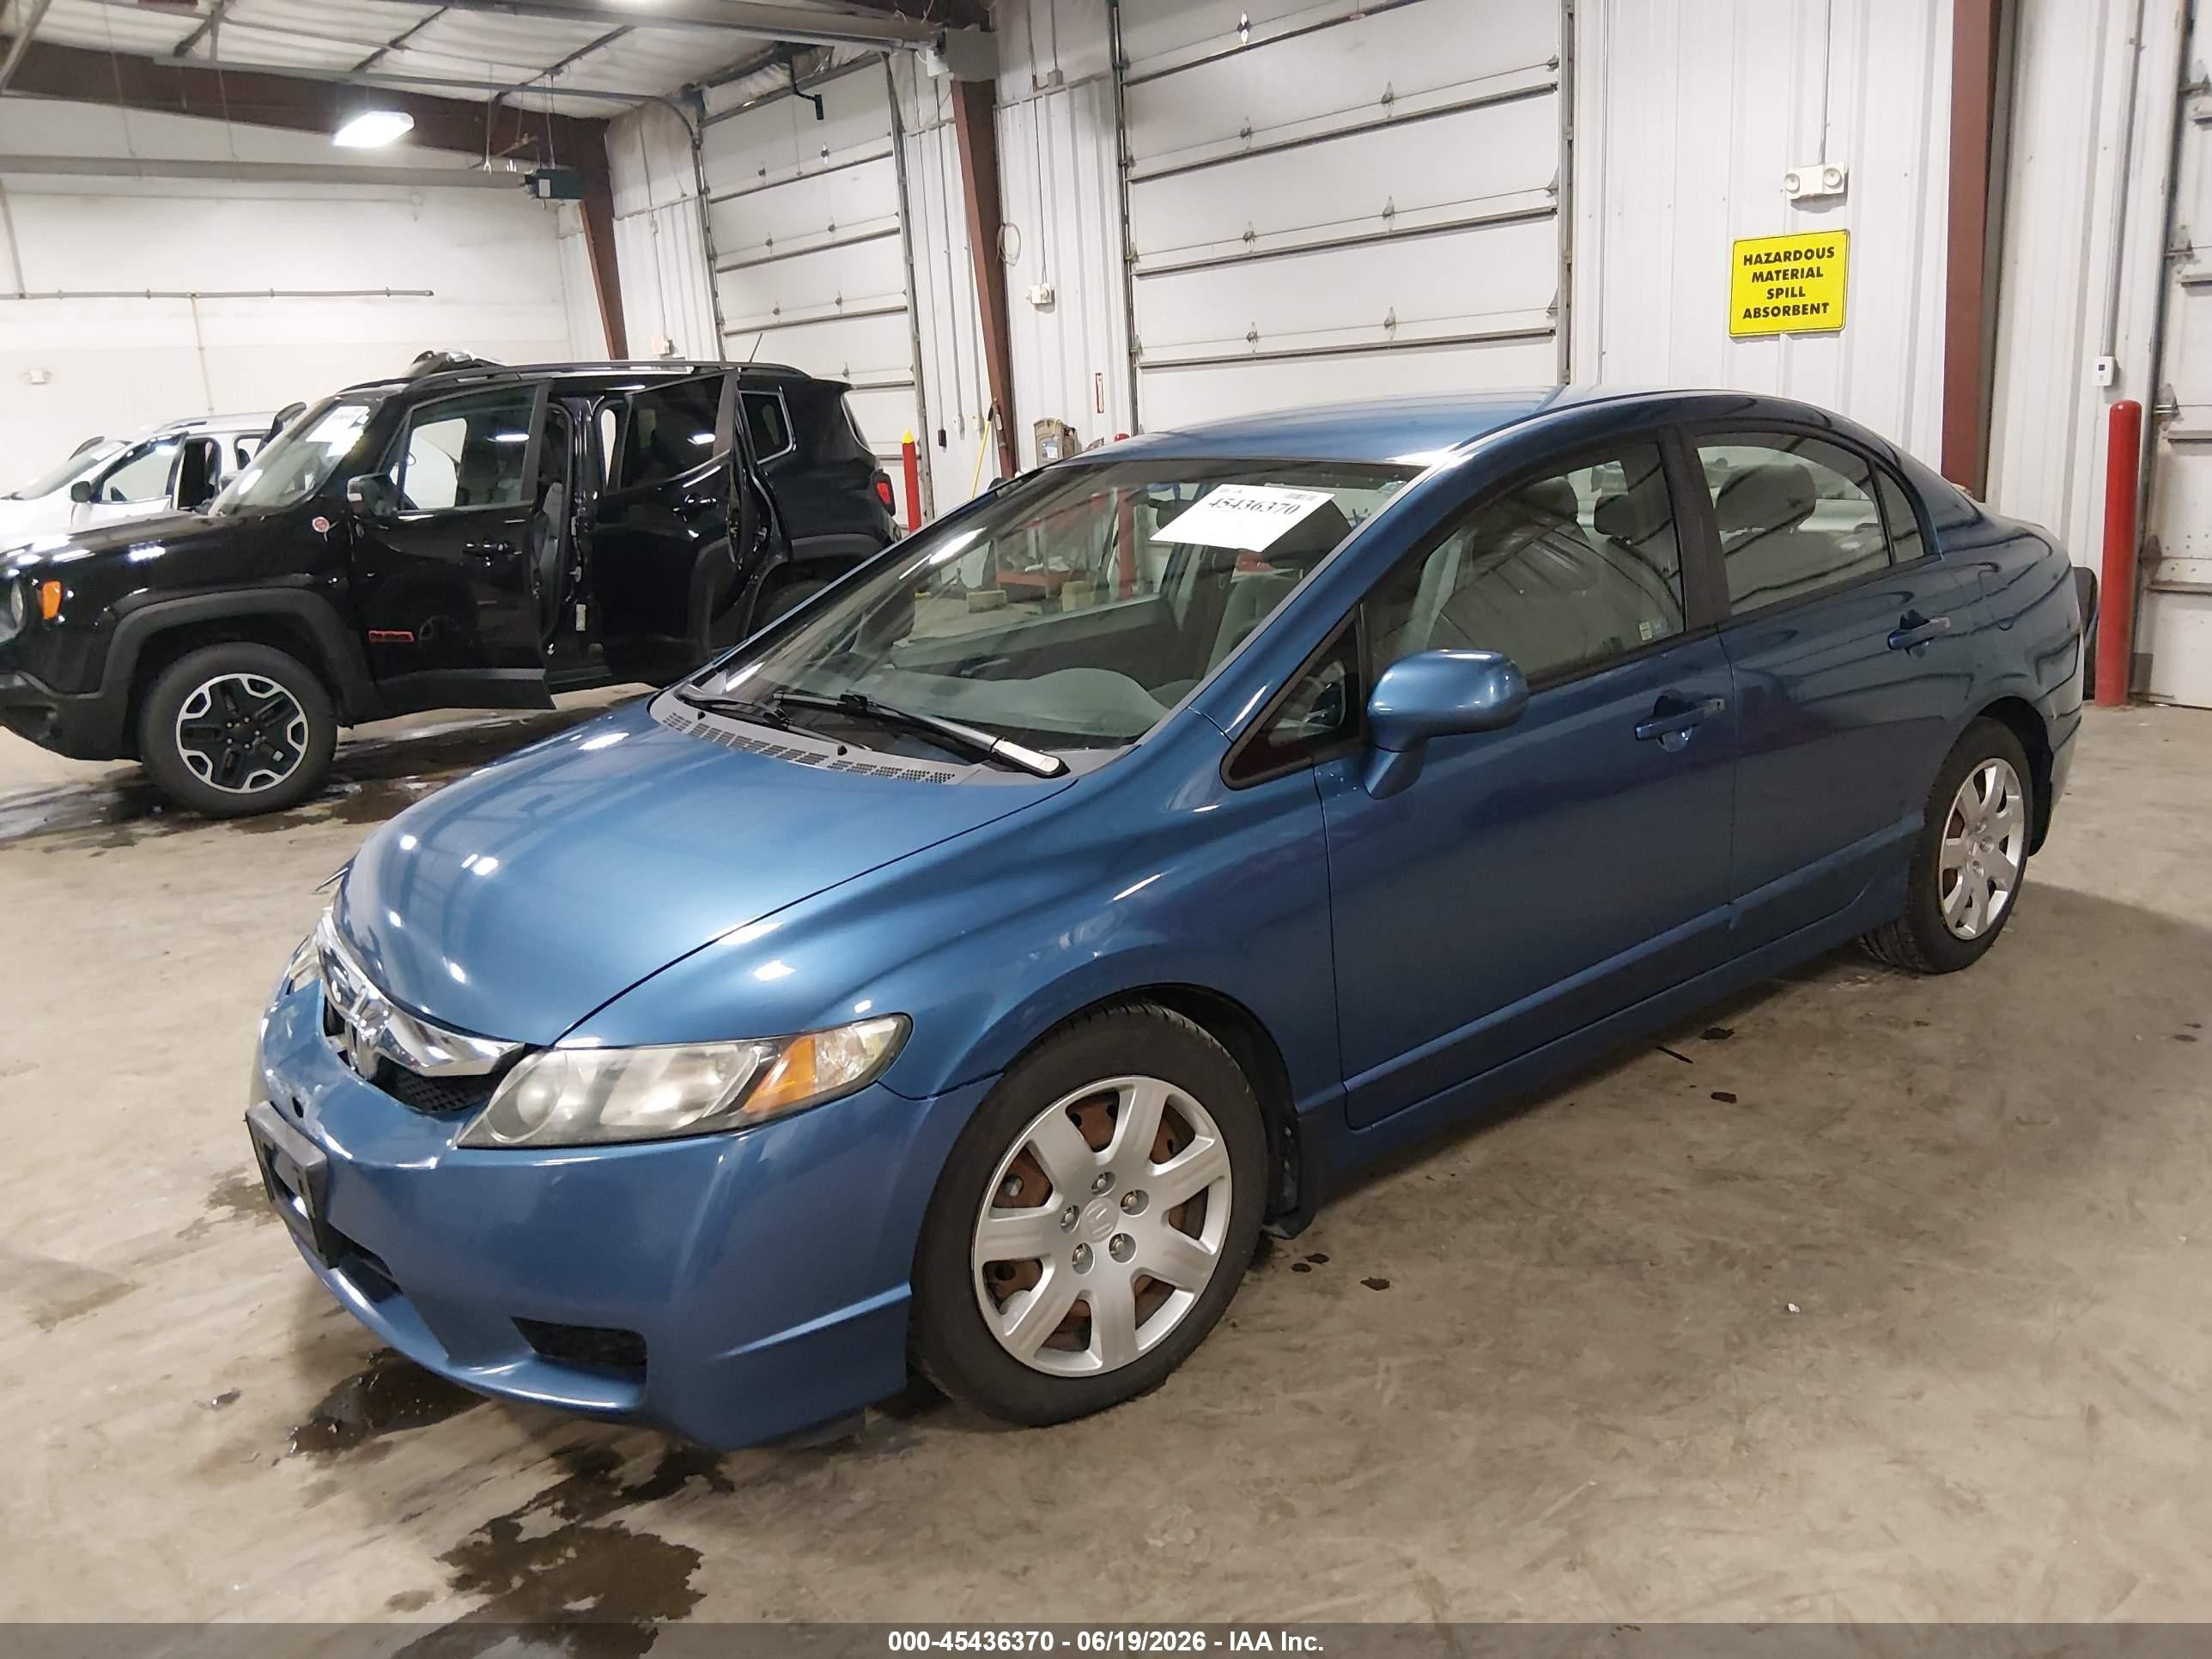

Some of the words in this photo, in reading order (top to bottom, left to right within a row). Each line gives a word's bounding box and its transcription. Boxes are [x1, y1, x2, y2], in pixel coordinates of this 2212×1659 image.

[1743, 246, 1835, 266] HAZARDOUS
[1751, 266, 1824, 283] MATERIAL
[1766, 286, 1806, 300] SPILL
[1742, 302, 1830, 319] ABSORBENT
[1208, 497, 1301, 515] 45436370
